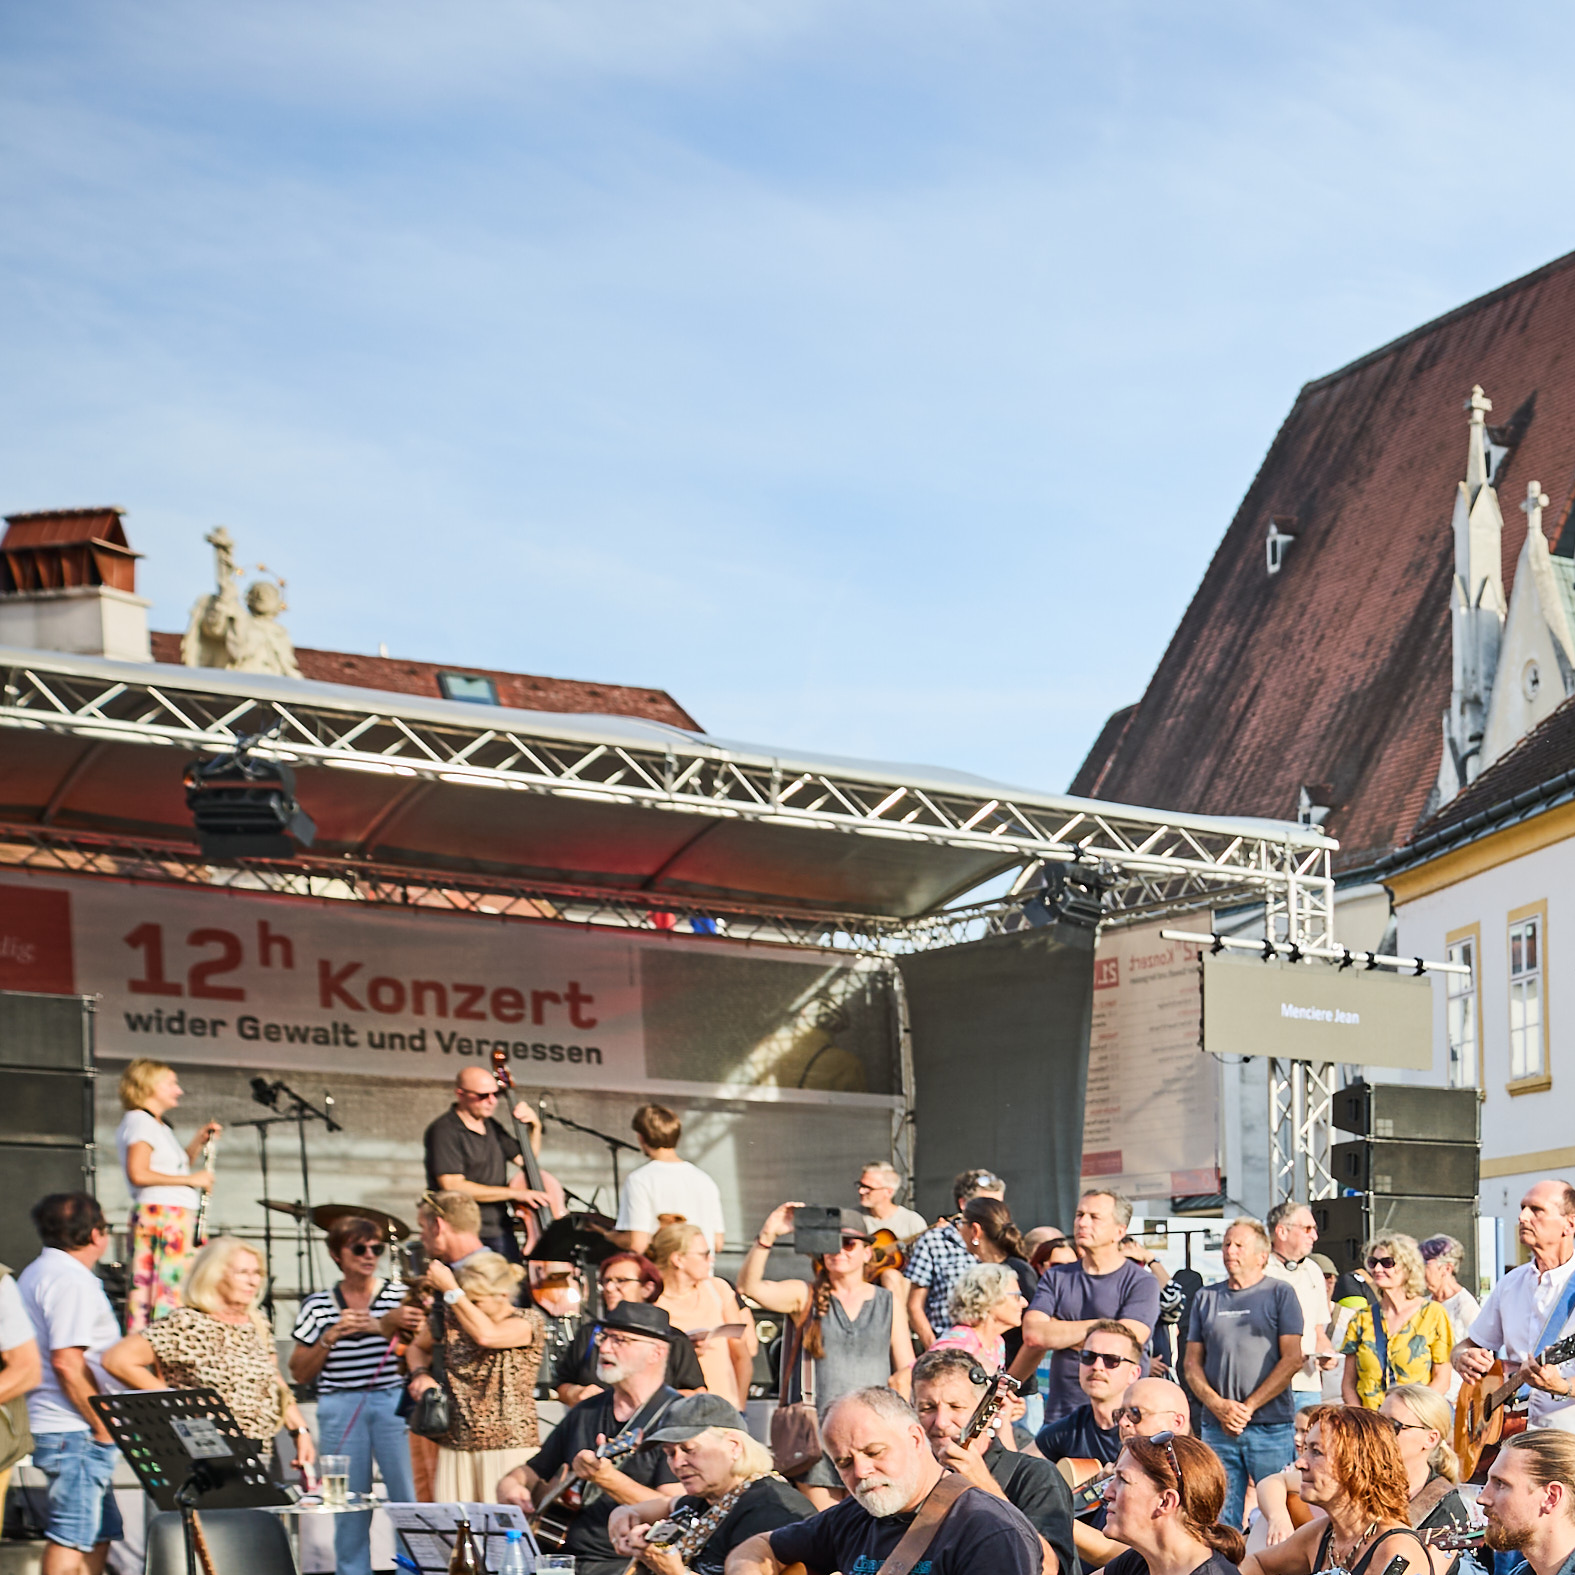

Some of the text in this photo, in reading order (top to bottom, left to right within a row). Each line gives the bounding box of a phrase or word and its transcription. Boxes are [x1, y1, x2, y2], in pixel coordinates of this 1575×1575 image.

[316, 958, 598, 1030] Konzert
[1334, 1008, 1360, 1024] Jean
[124, 1008, 604, 1066] wider Gewalt und Vergessen
